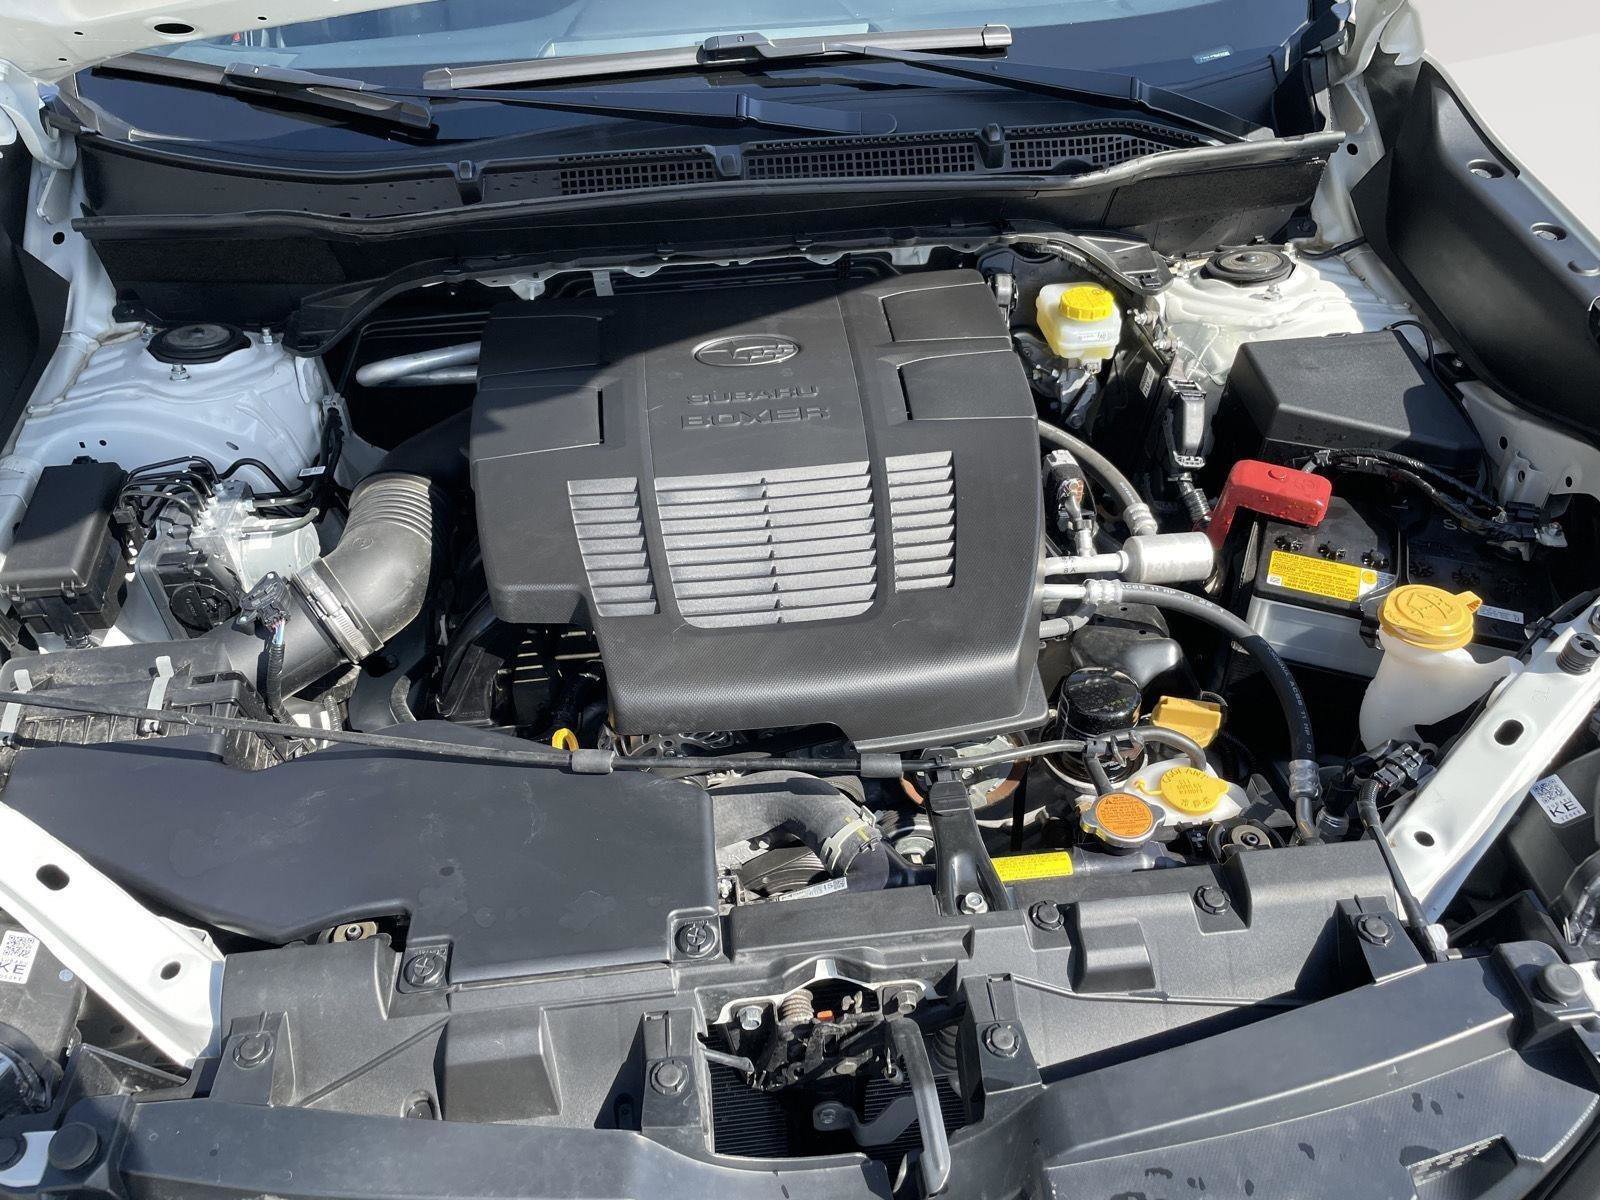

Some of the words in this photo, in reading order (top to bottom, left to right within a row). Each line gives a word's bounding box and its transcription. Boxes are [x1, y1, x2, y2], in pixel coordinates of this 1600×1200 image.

[687, 385, 820, 405] SUBARU
[681, 407, 831, 429] BOXER
[1550, 800, 1577, 817] KE
[0, 961, 26, 975] KE
